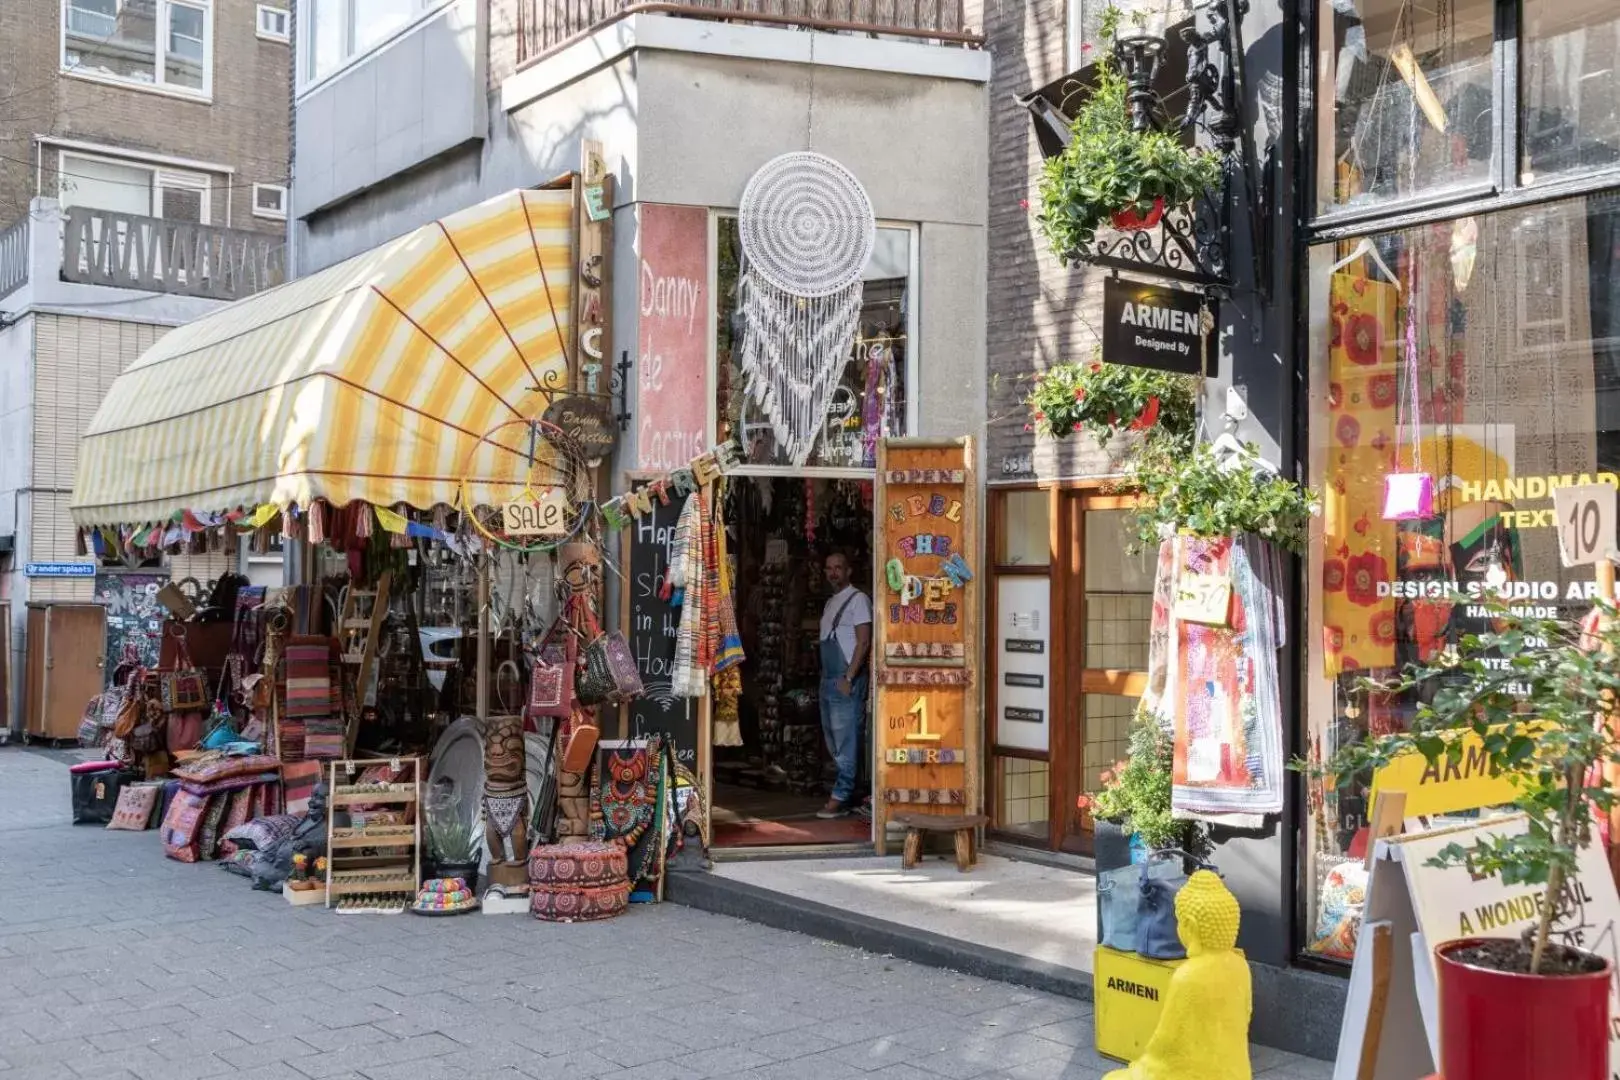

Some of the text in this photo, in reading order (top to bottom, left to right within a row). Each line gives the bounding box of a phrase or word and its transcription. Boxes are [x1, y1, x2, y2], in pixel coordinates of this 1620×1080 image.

[641, 259, 699, 335] Danny
[1121, 302, 1199, 336] ARMEN
[639, 333, 663, 391] de
[1135, 335, 1190, 356] Designed By
[1569, 499, 1600, 560] 10
[1376, 581, 1458, 598] DESIGN
[635, 604, 652, 630] in
[636, 635, 676, 676] Hou
[905, 695, 942, 740] 1
[1420, 745, 1488, 785] ARM
[1459, 911, 1475, 937] A
[1107, 975, 1160, 1002] ARMENI
